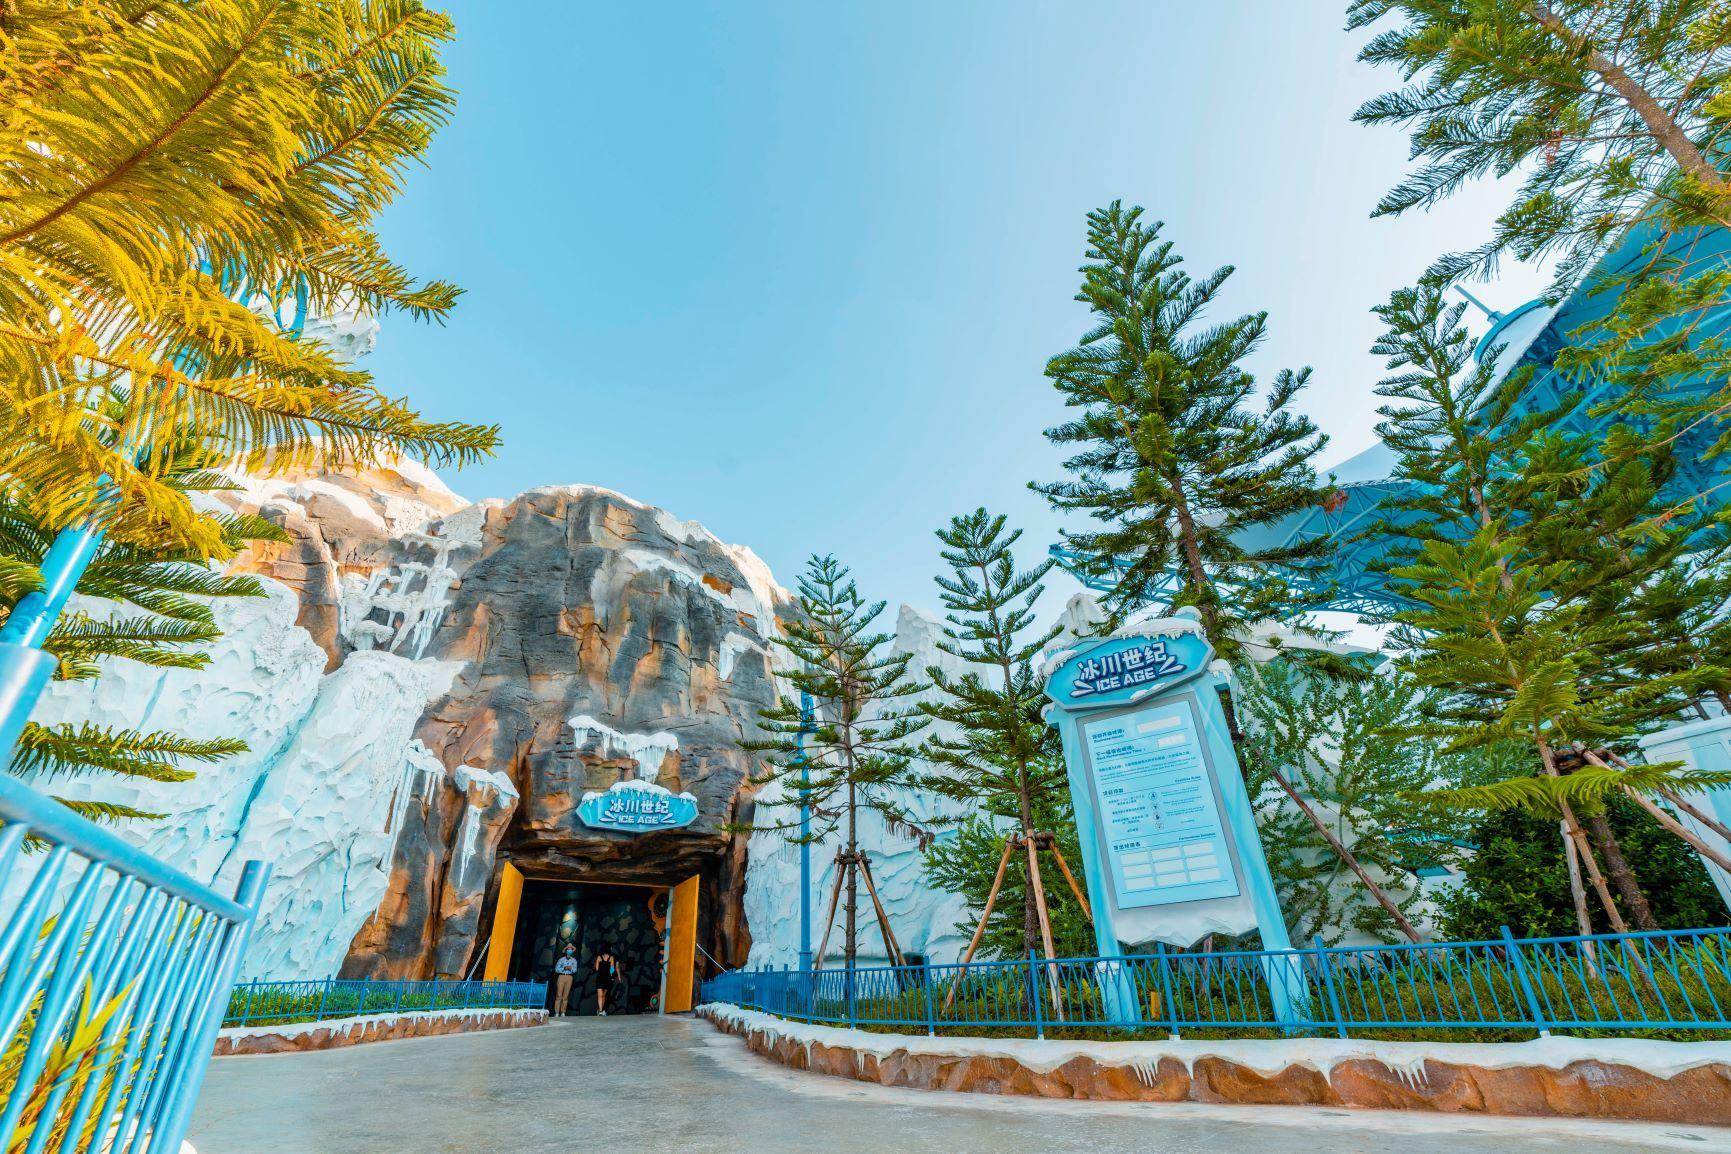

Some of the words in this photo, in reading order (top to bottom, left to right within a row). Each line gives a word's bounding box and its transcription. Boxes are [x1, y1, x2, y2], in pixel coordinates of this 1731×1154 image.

[1078, 641, 1167, 680] 冰川世纪
[1097, 676, 1121, 692] ICE
[1123, 667, 1156, 685] AGE
[610, 799, 670, 814] 冰川世纪
[618, 815, 635, 824] ICE
[637, 815, 659, 824] AGE
